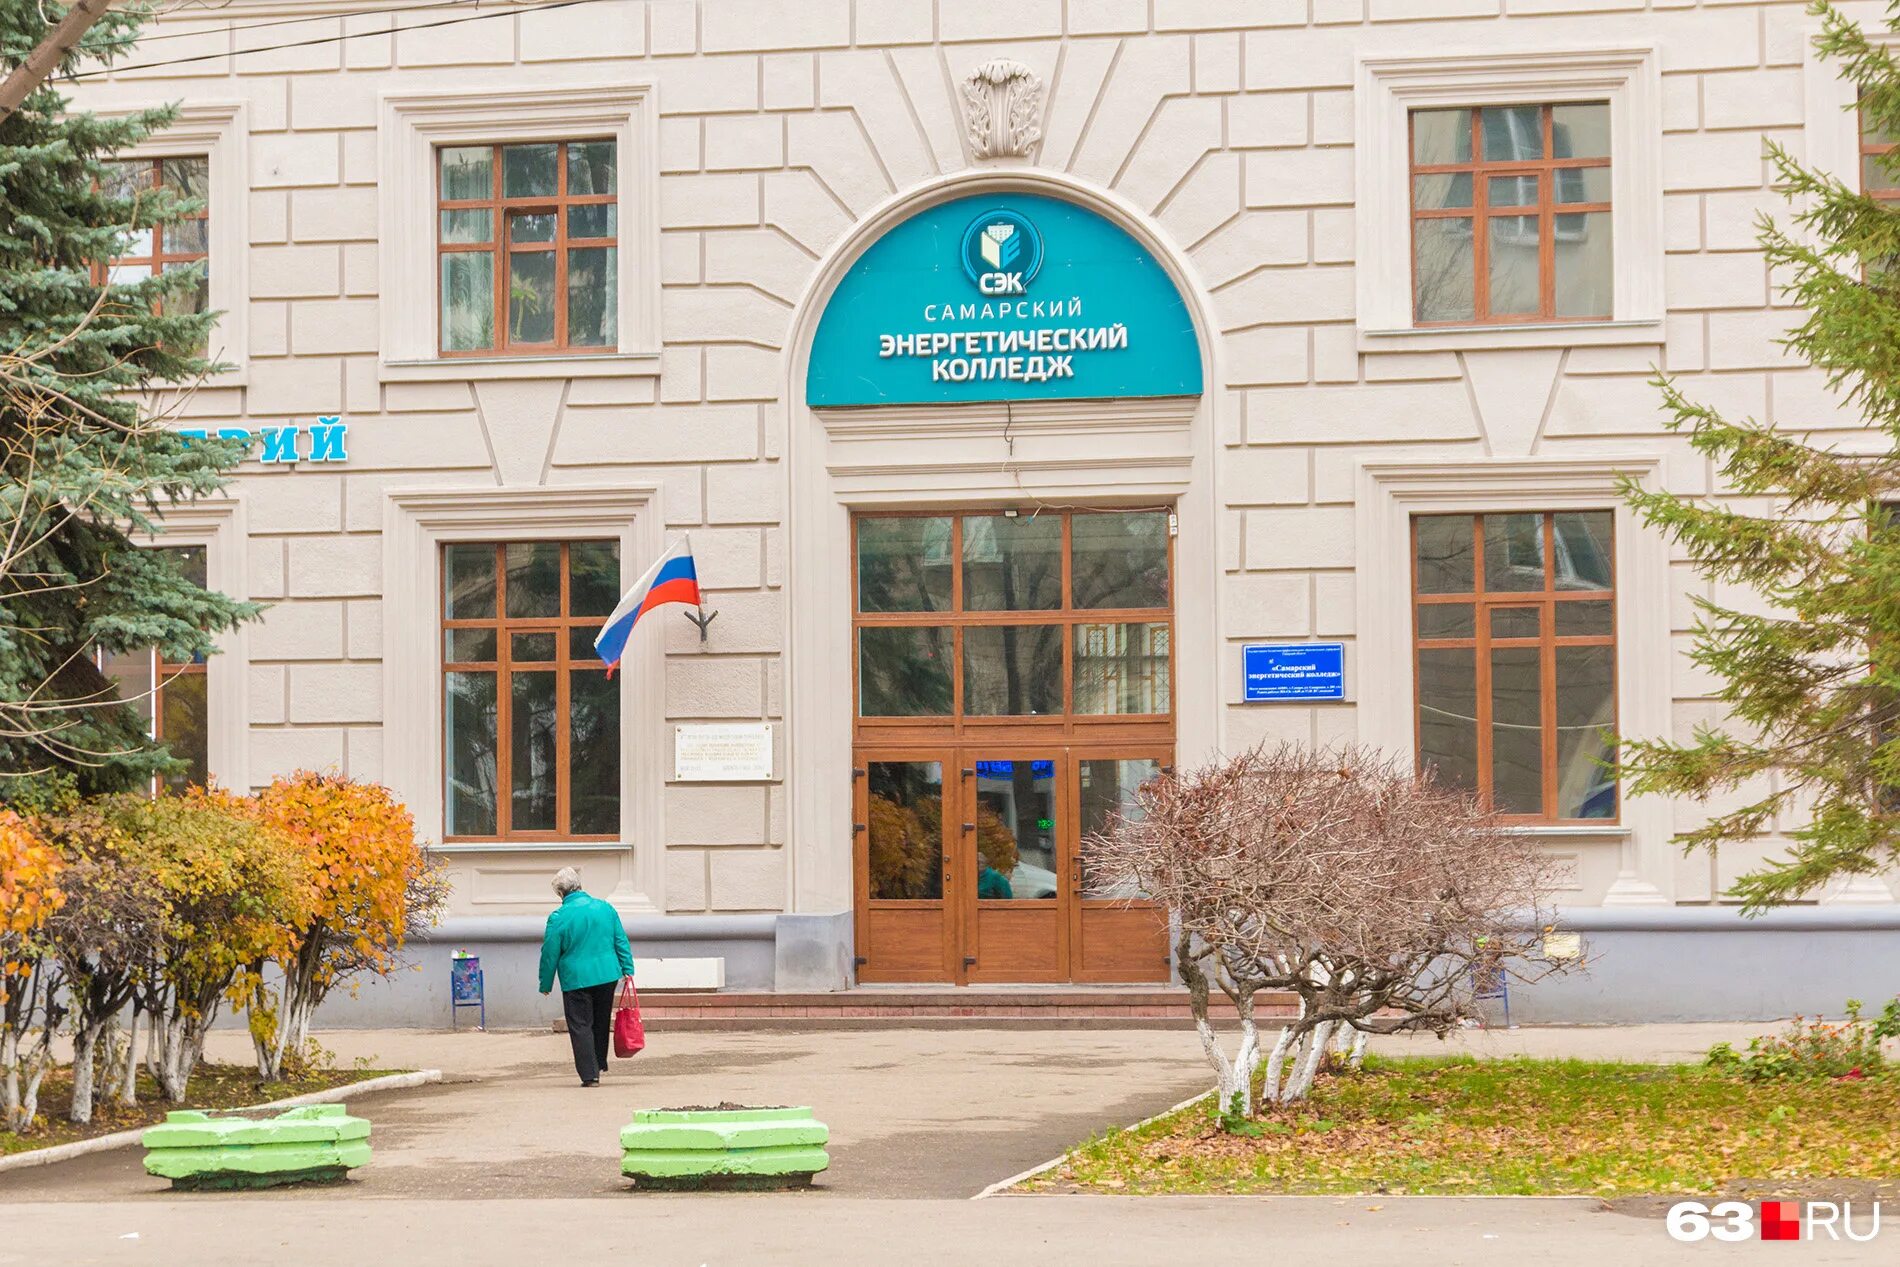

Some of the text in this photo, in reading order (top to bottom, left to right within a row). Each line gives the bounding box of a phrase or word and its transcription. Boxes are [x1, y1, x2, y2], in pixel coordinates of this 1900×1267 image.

[979, 271, 1024, 294] СЭК
[924, 297, 1083, 321] САМАРСКИЙ
[879, 323, 1128, 357] ЭНЕРГЕТИЧЕСКИЙ
[932, 355, 1074, 383] КОЛЛЕДЖ
[1248, 672, 1305, 680] энергетический
[1271, 664, 1316, 672] «Самарский
